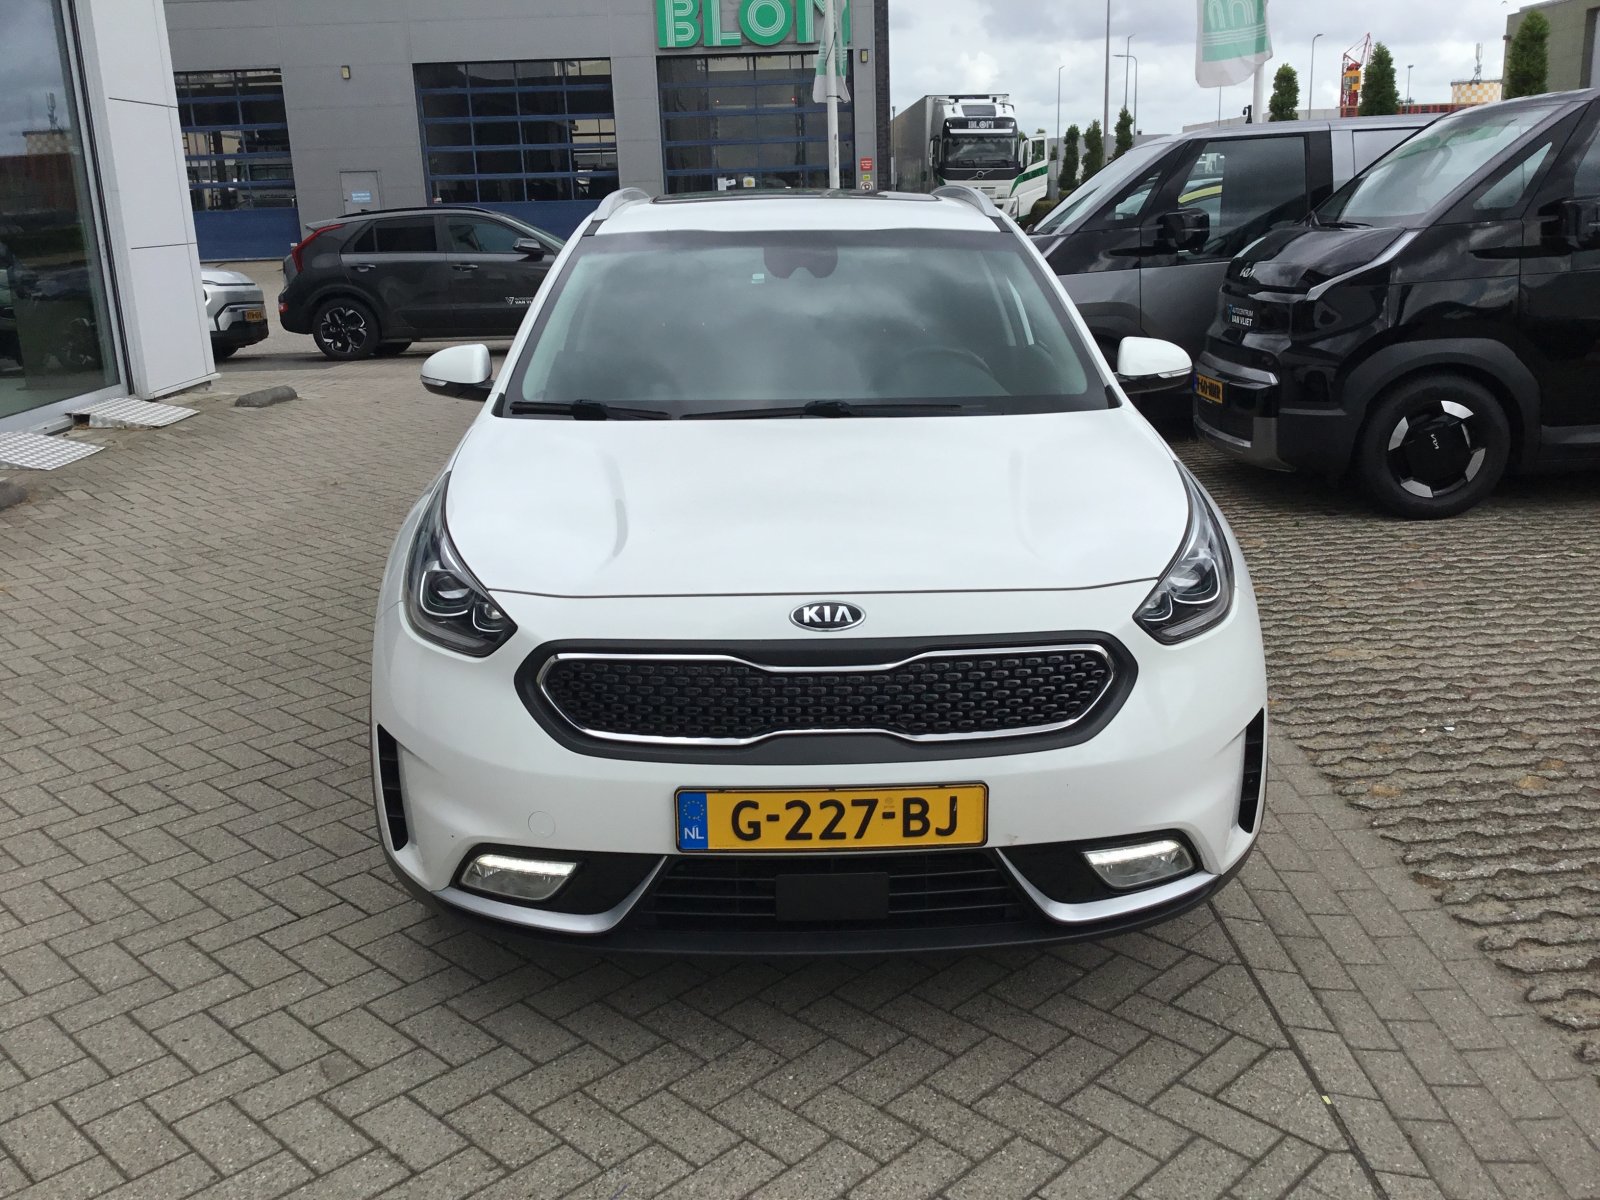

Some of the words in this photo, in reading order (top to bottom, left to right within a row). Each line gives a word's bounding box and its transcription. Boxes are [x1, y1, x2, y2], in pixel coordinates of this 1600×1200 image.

[803, 605, 854, 623] KIA
[684, 826, 705, 840] NL
[731, 796, 958, 842] G-227-BJ
